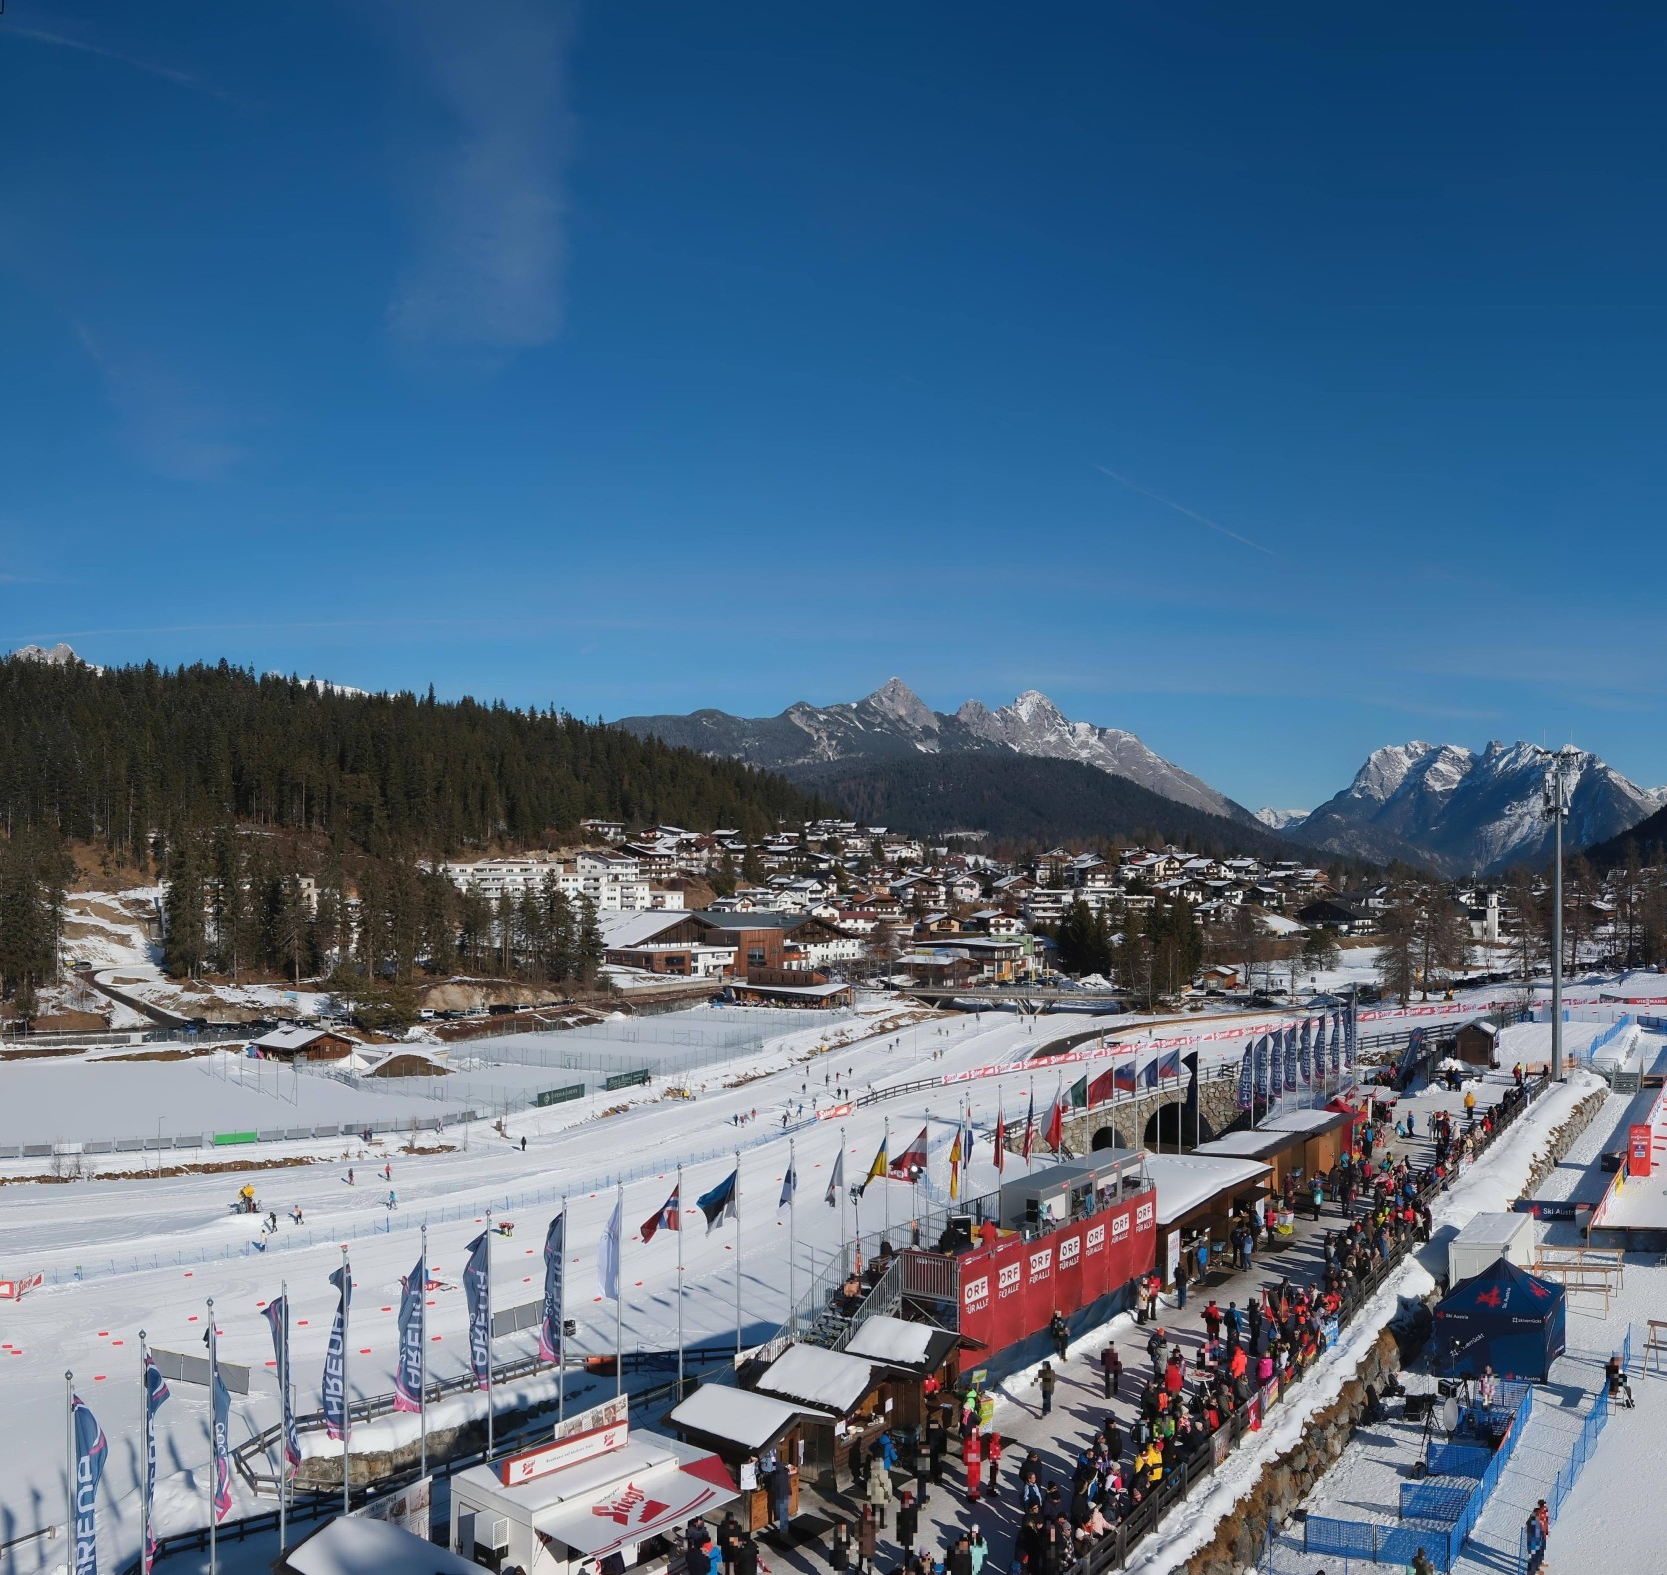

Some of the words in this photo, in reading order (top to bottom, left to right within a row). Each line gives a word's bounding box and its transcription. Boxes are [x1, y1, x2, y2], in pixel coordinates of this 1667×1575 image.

[1137, 1205, 1152, 1220] ORF
[1543, 1207, 1554, 1215] Ski
[1555, 1208, 1575, 1216] Austr
[1114, 1216, 1129, 1231] ORF
[1088, 1228, 1104, 1244] ORF
[1062, 1240, 1079, 1257] ORF
[1031, 1252, 1050, 1271] ORF
[1001, 1268, 1018, 1285] ORF
[966, 1280, 987, 1299] ORF
[592, 1481, 645, 1526] Stiegl
